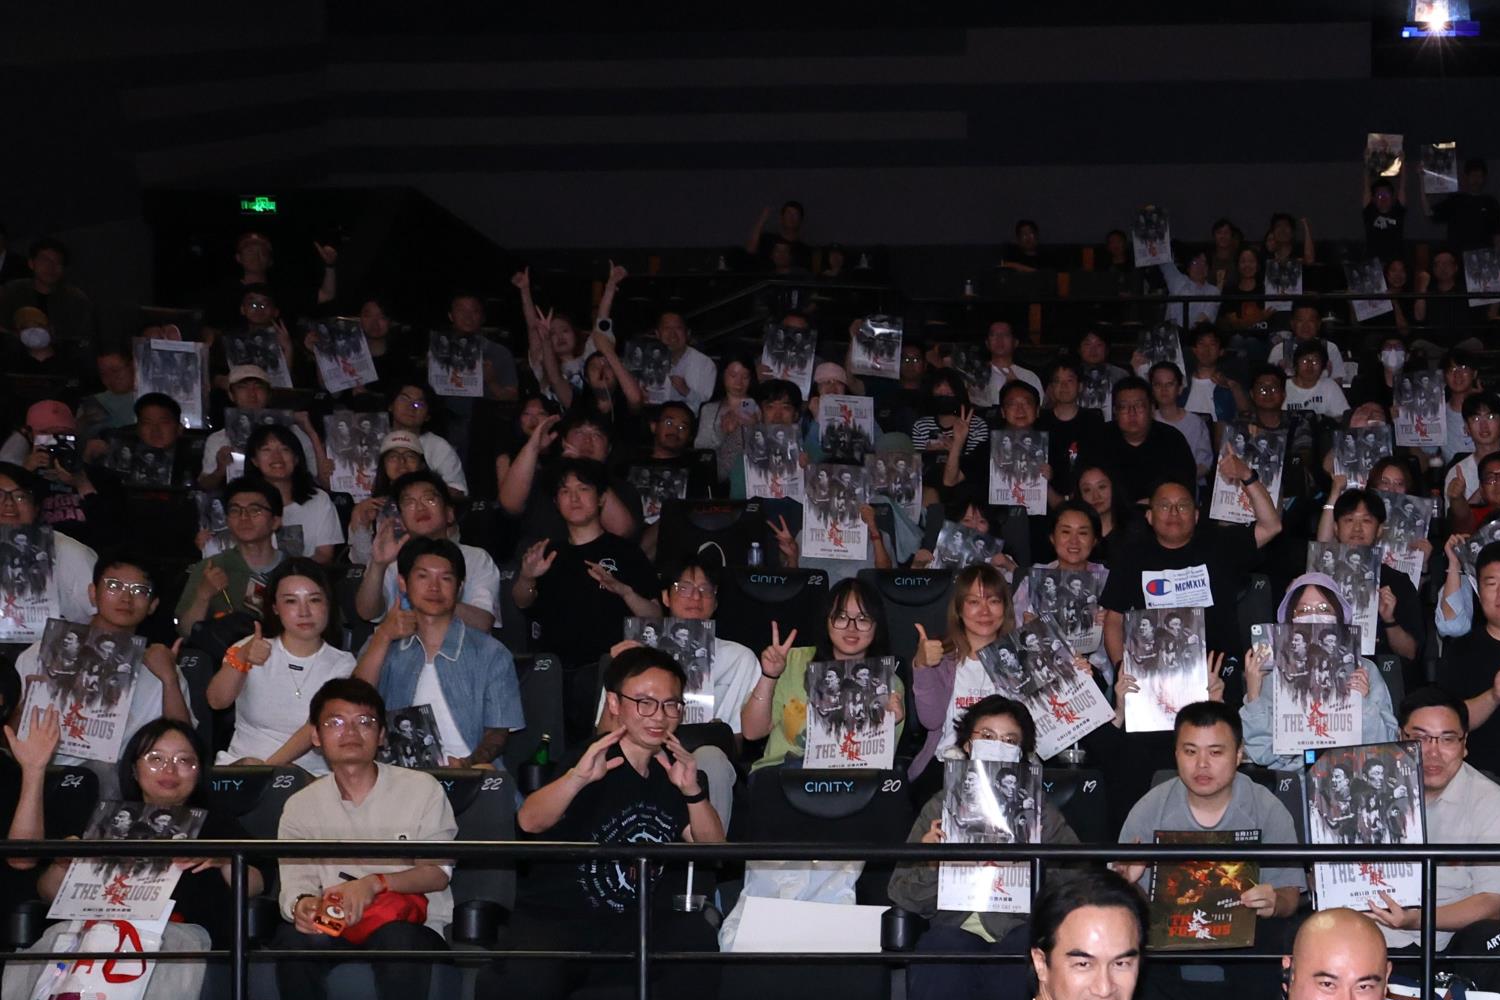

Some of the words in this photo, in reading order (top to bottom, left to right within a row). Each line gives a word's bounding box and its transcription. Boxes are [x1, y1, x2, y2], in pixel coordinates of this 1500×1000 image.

[750, 574, 788, 585] CINITY
[894, 576, 932, 586] CINITY
[1175, 578, 1207, 593] MCMXIX
[1282, 713, 1304, 732] THE
[815, 744, 837, 760] THE
[61, 774, 84, 788] 24
[272, 775, 295, 788] 23
[480, 777, 503, 790] 22
[804, 780, 854, 793] CINITY
[881, 779, 902, 793] 20
[1082, 780, 1097, 793] 19
[1279, 778, 1292, 792] 18
[69, 882, 102, 901] THE
